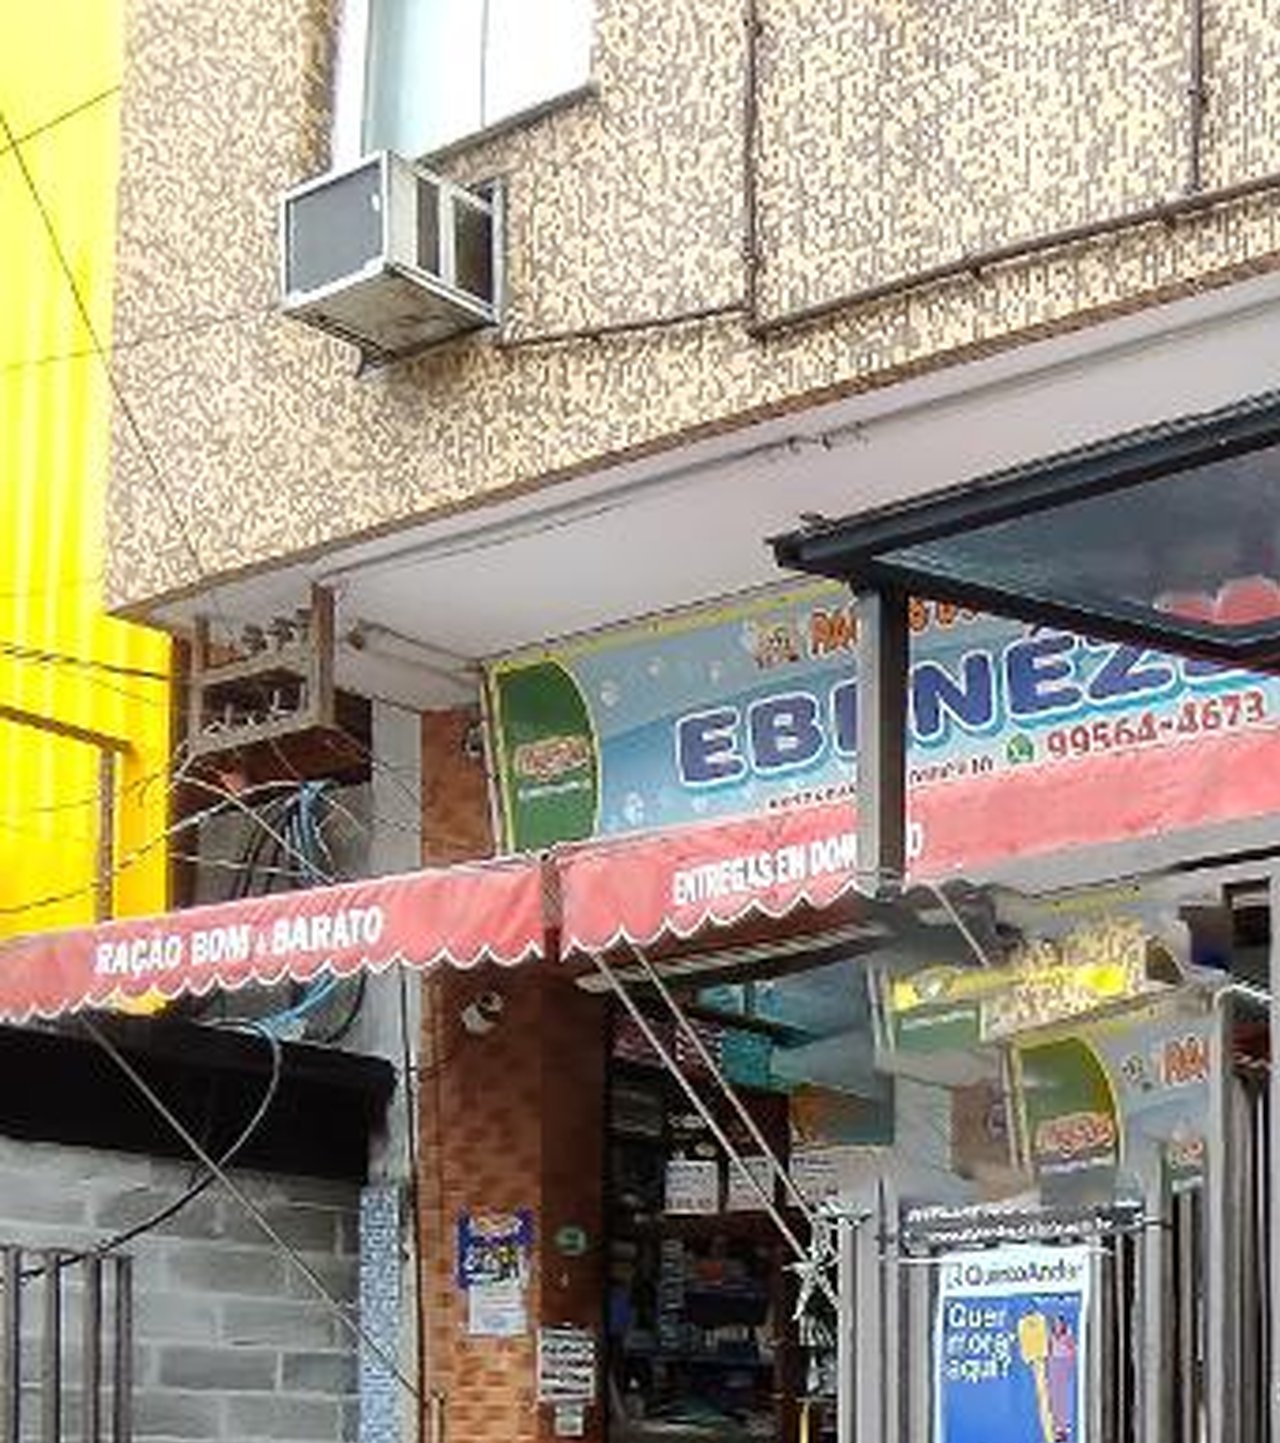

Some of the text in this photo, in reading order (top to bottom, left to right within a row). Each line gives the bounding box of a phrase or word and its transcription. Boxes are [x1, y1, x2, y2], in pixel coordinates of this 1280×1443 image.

[676, 629, 1247, 786] EBNEZ
[673, 850, 776, 906] ENTREGAS
[191, 924, 251, 967] BOM
[272, 904, 383, 956] BARATO
